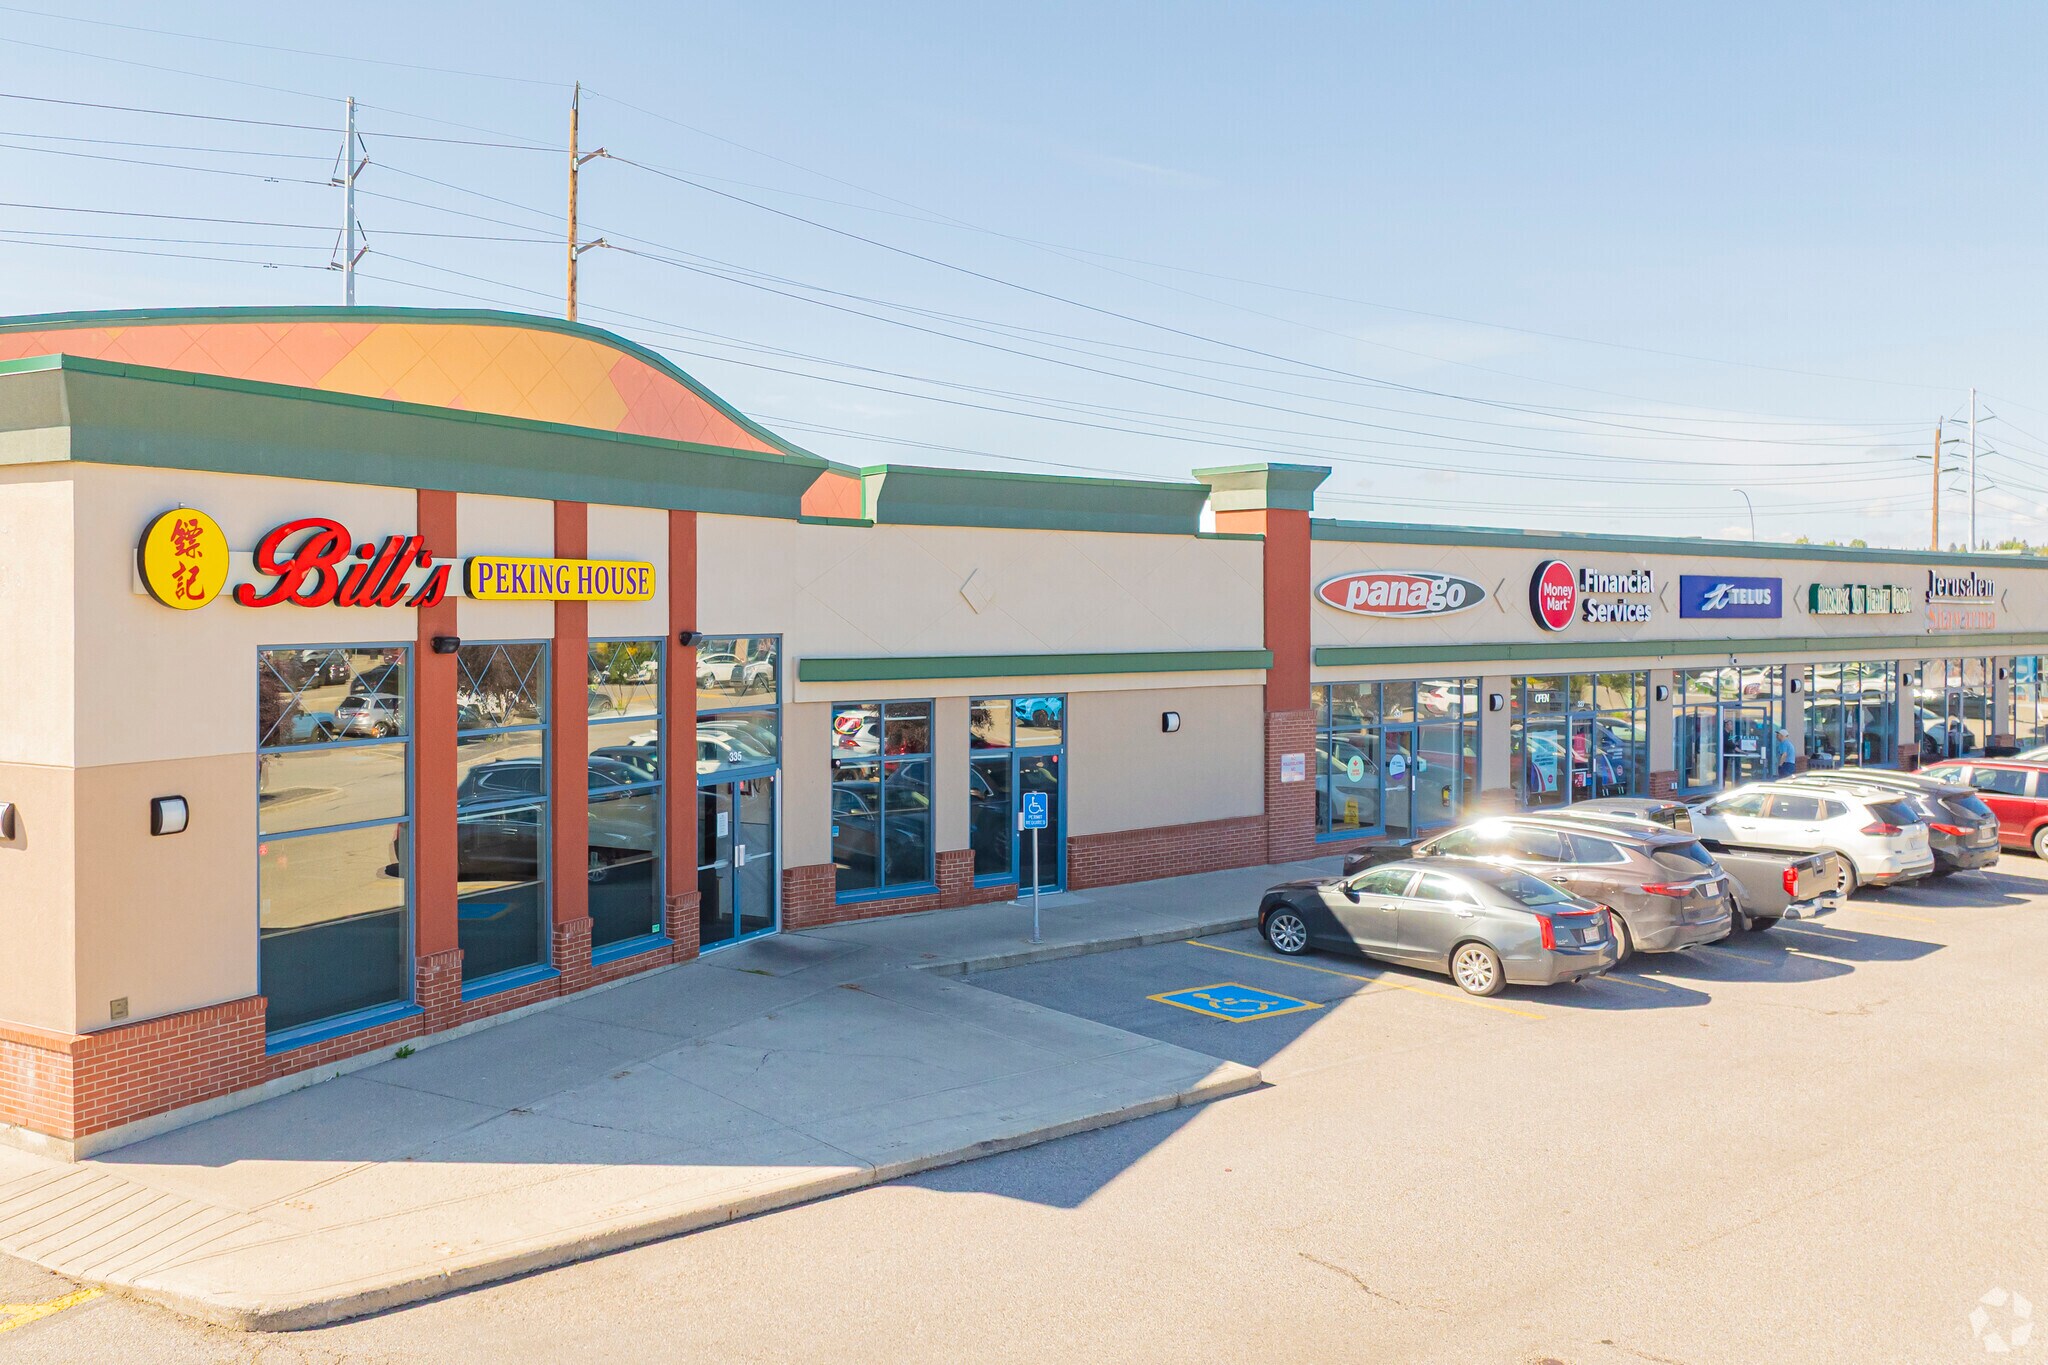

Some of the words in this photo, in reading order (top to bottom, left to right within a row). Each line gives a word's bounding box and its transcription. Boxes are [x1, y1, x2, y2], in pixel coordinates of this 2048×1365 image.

[233, 517, 452, 608] Bill's
[477, 562, 571, 595] PEKING
[577, 565, 650, 595] HOUSE
[1543, 582, 1573, 600] Money
[1582, 568, 1655, 594] Financial
[1928, 570, 1996, 599] Jerusalem
[1345, 576, 1467, 611] panago
[1547, 597, 1568, 611] Mart
[1729, 588, 1771, 605] TELUS
[1584, 598, 1652, 623] Services
[1534, 693, 1550, 704] OPEN
[729, 751, 743, 762] 335
